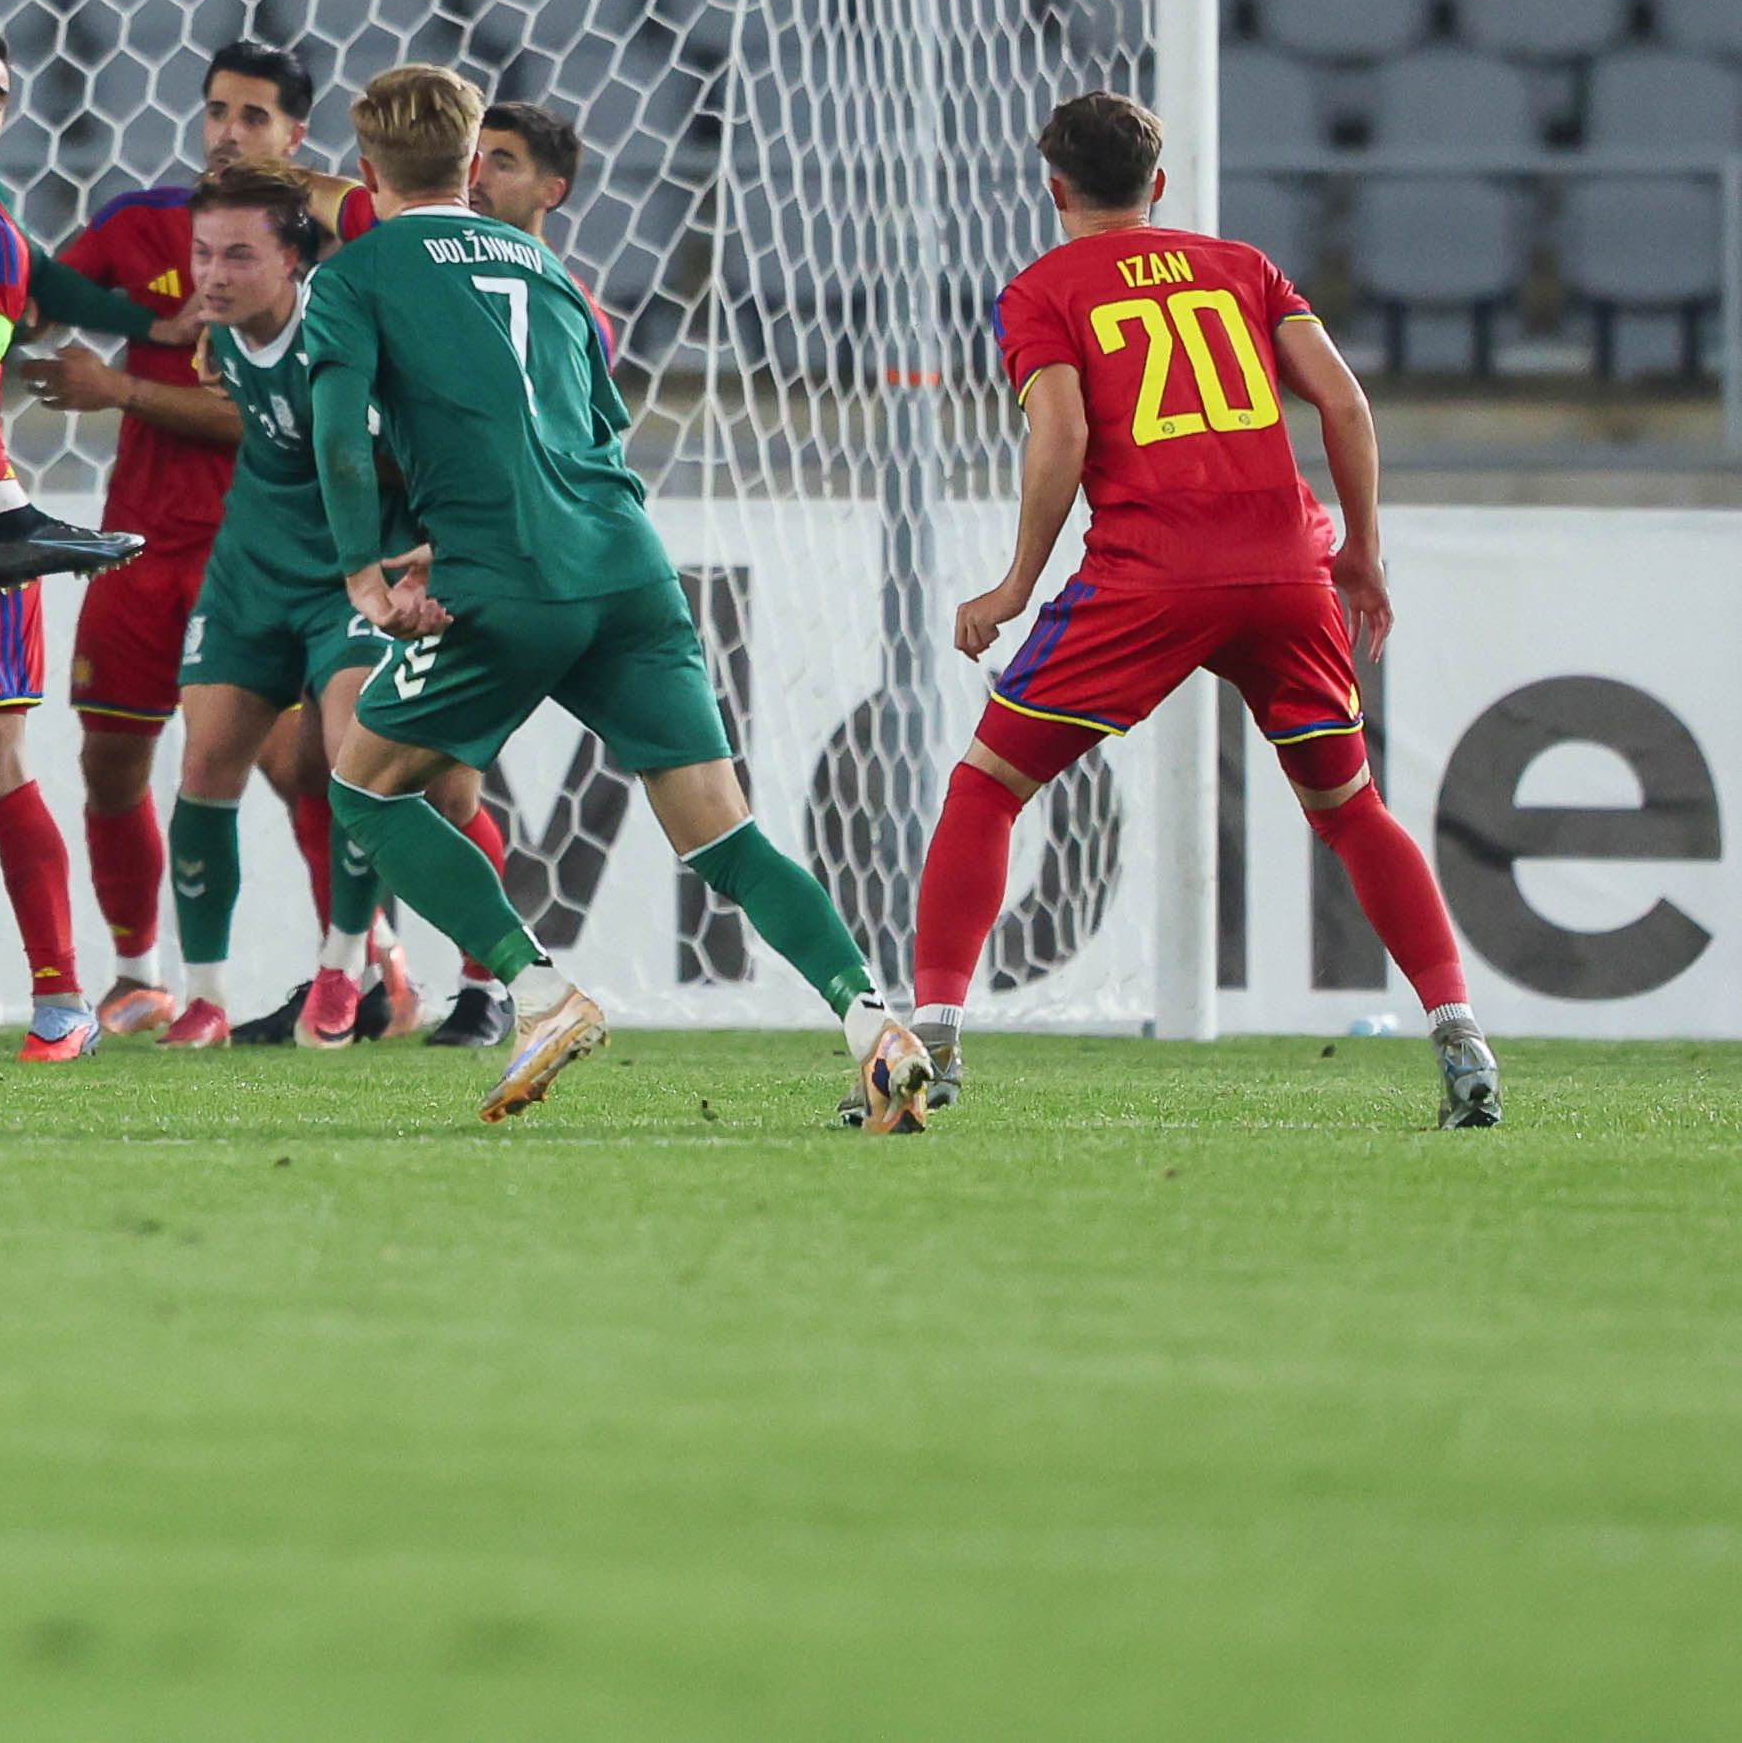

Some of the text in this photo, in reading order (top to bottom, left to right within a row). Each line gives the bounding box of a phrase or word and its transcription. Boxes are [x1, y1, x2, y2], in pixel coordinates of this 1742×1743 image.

[1116, 250, 1195, 288] IZAN
[470, 274, 538, 418] 7
[1089, 289, 1280, 447] 20
